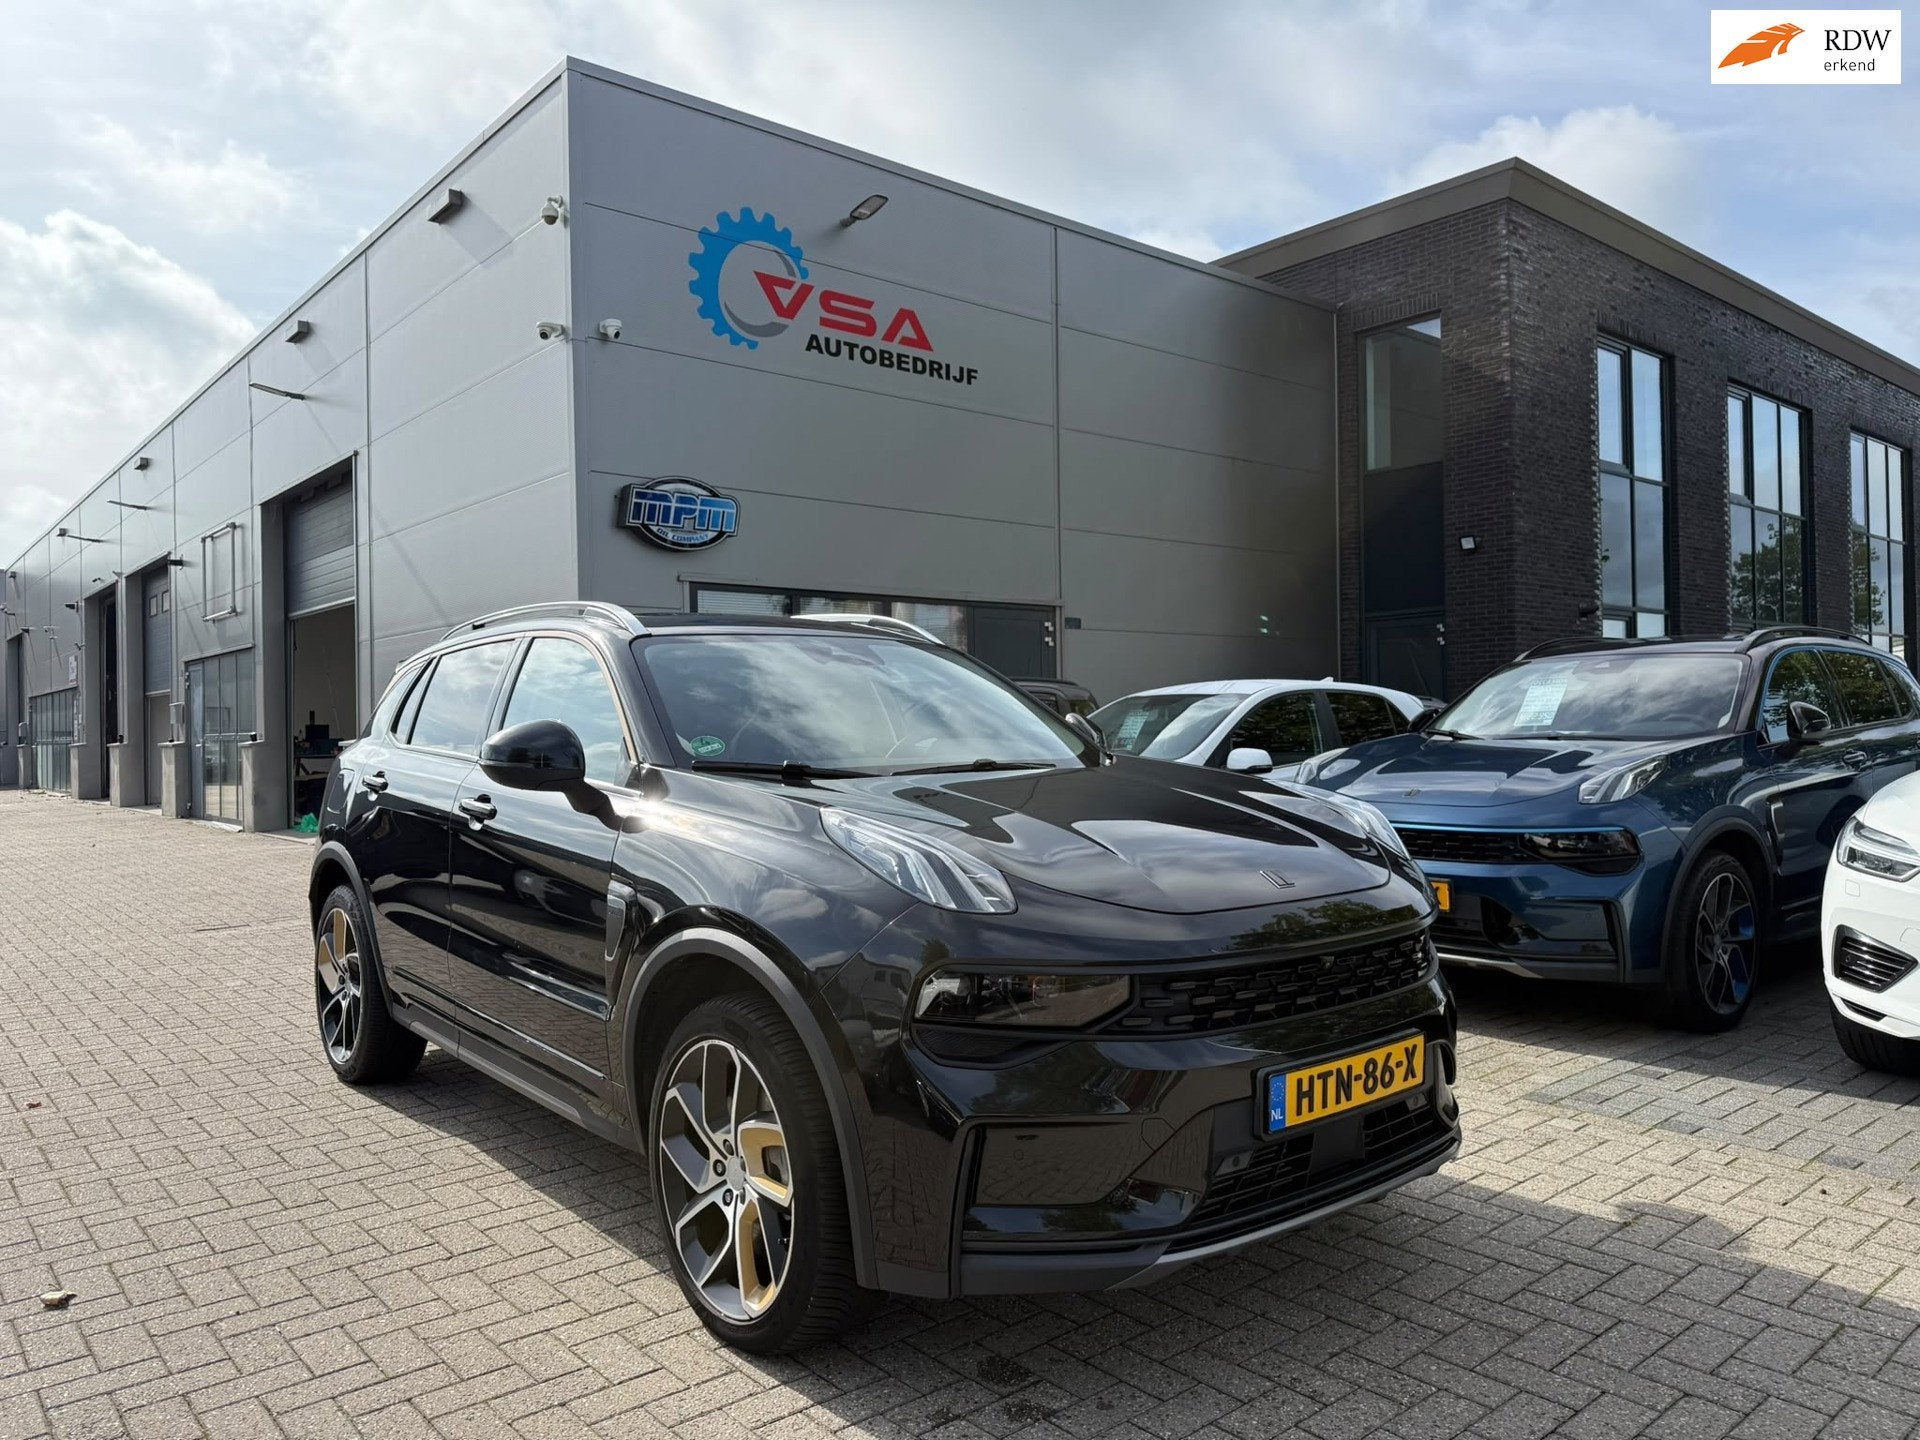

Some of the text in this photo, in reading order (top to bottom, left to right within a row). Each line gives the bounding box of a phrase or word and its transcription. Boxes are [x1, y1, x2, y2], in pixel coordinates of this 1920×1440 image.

[753, 270, 934, 352] VSA
[805, 333, 979, 386] AUTOBEDRIJF
[672, 533, 710, 543] COMPANY
[1296, 1043, 1418, 1118] HTN-86-X
[1270, 1109, 1284, 1122] NL
